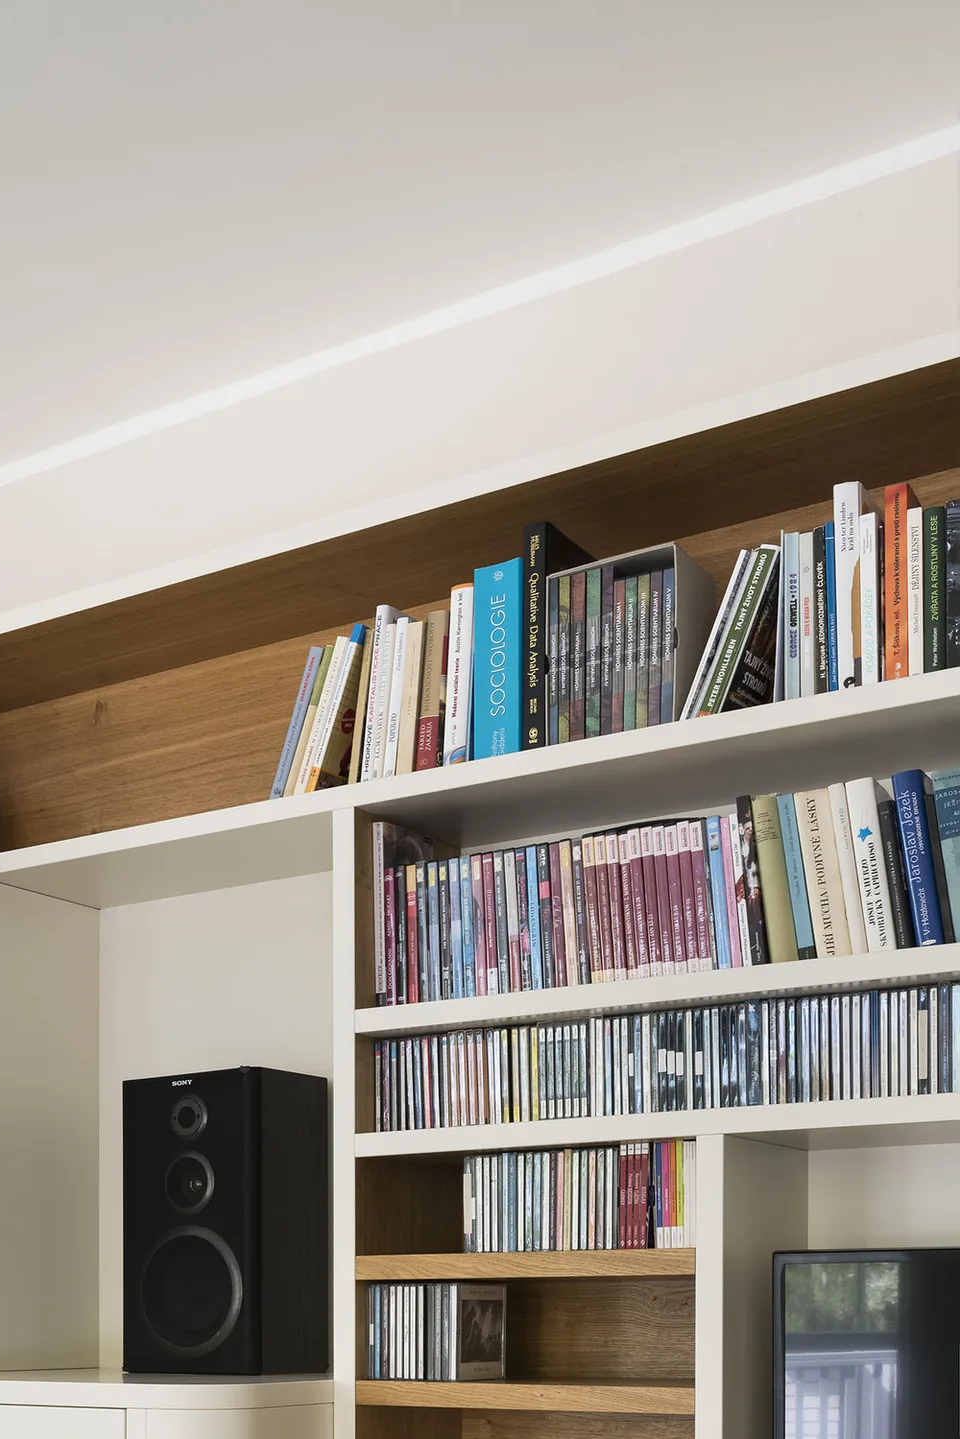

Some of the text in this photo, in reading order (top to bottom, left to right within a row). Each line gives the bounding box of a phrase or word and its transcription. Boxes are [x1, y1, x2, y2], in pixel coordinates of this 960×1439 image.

[893, 519, 901, 536] proti
[815, 561, 824, 587] ČLOVĚK
[909, 525, 920, 590] DĚJINY ŠÍLENSTVÍ
[930, 544, 938, 581] ROSTLINY
[735, 552, 767, 632] TAJNÝ ŽIVOT STROMŮ
[816, 589, 825, 644] JEDNOROZMĚRNÝ
[893, 577, 901, 606] Výchova
[930, 589, 939, 621] ZVÍŘATA
[428, 622, 436, 657] SVOBODY
[490, 594, 506, 717] SOCIOLOGIE
[527, 572, 540, 688] Qualitative Data Analysis
[707, 638, 737, 708] PETER WOHLLEBEN
[865, 639, 874, 673] POMOC
[364, 615, 383, 772] HRDINOVÉ KAPITALISTICKÉ PRÁCE
[911, 791, 920, 815] DIVADLO
[539, 848, 547, 866] arte
[898, 790, 921, 883] Jaroslav Ježek
[914, 815, 924, 851] OSVOBOZENÉ
[806, 798, 835, 956] JIŘÍ MUCHA PODIVNÉ LÁSKY
[862, 859, 875, 926] JOSEF SCHERZO
[868, 842, 880, 896] CAPRICCIOSO
[918, 888, 931, 936] V. Holzknecht
